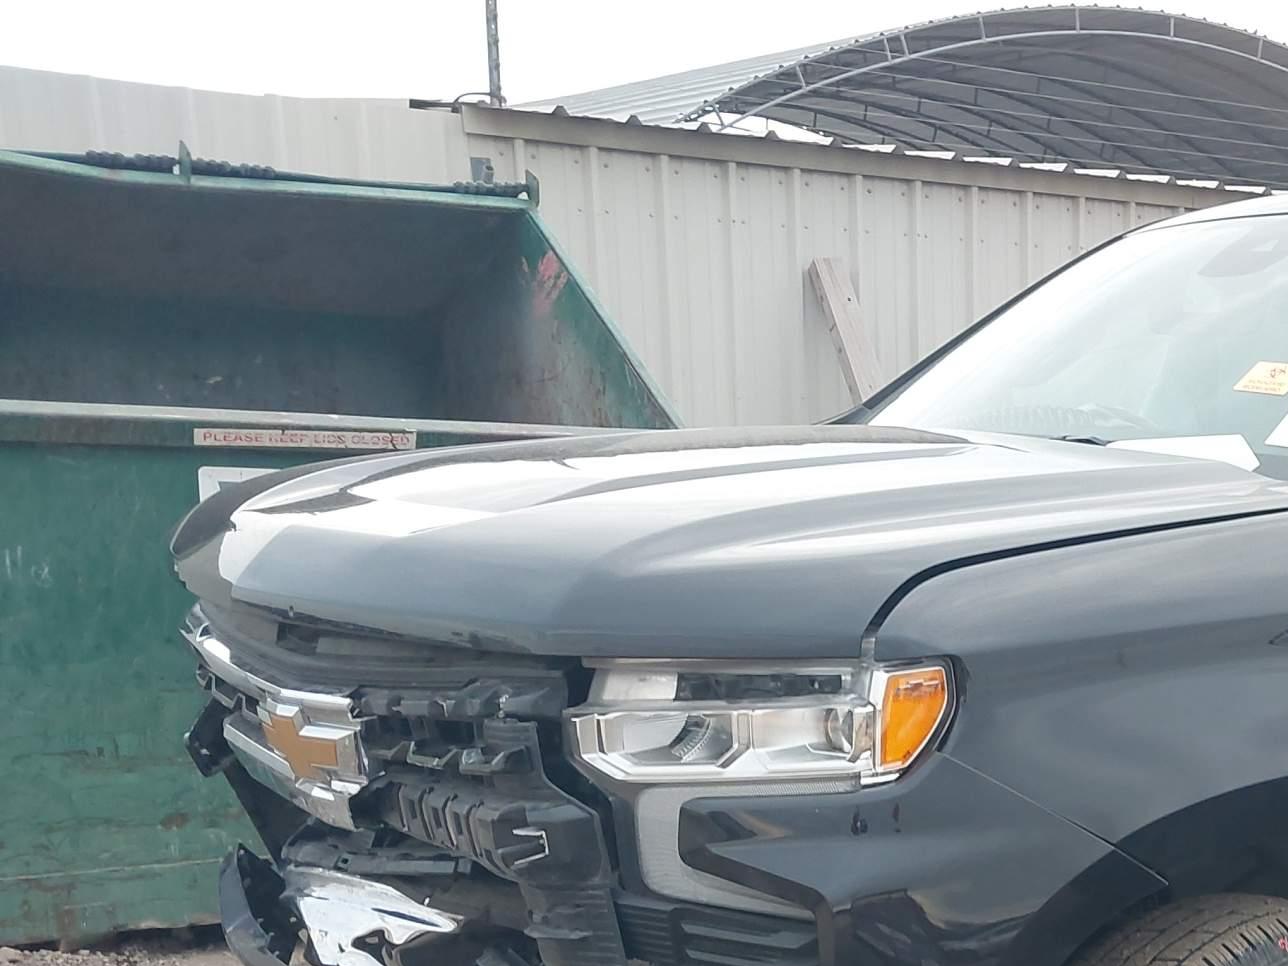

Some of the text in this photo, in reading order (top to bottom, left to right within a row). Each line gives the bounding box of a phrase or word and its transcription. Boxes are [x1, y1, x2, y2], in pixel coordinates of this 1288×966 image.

[203, 431, 265, 443] PLEASE
[313, 434, 347, 445] LIDS
[351, 434, 410, 447] CLOSED
